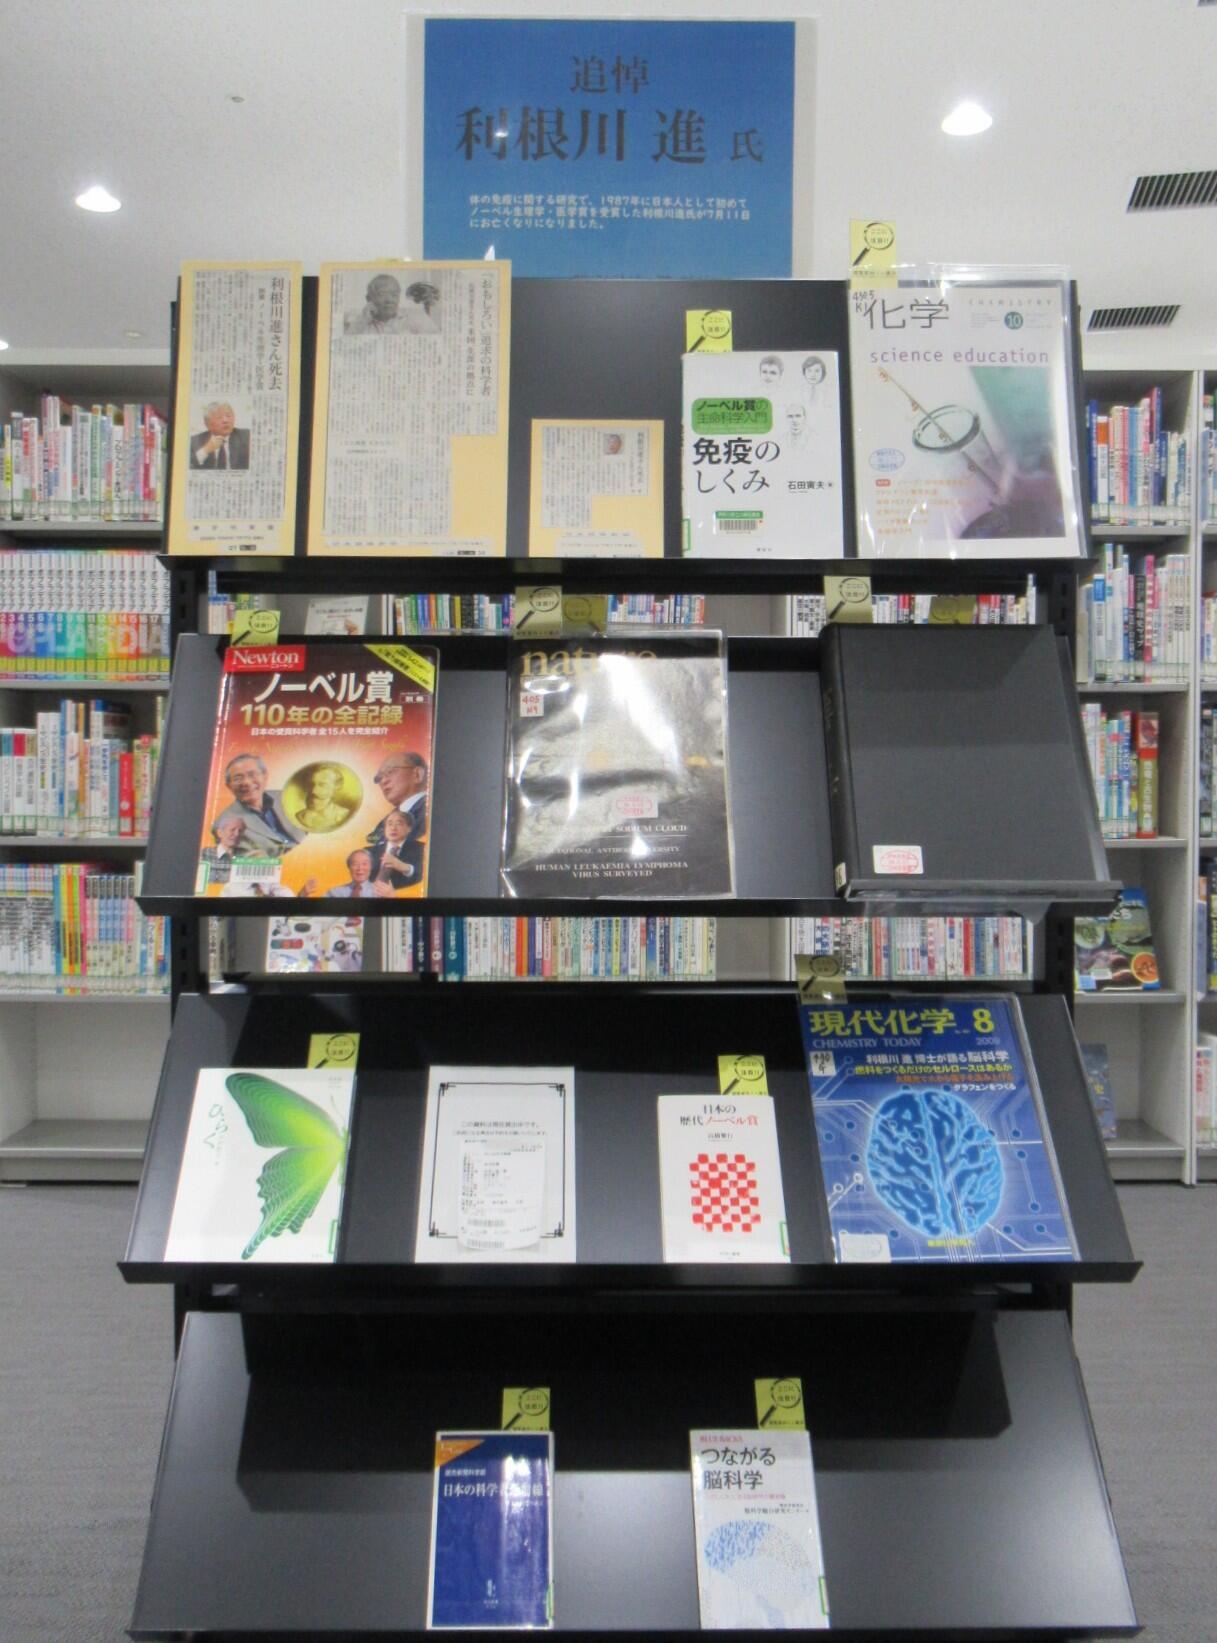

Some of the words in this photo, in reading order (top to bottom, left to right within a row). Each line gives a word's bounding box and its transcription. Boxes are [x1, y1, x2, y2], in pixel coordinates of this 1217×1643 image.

[570, 55, 649, 94] 追悼
[456, 105, 626, 162] 利根川
[652, 108, 706, 164] 進
[730, 128, 764, 163] 氏
[864, 298, 949, 330] 化学
[1007, 314, 1022, 327] 10
[268, 277, 285, 391] 利根川進さん死去
[870, 348, 943, 363] science
[953, 348, 1049, 363] education
[696, 400, 768, 412] ノーベル賞の
[692, 437, 781, 465] 免疫の
[696, 469, 770, 494] しくみ
[232, 649, 299, 665] Newton
[254, 670, 394, 704] ノーベル賞
[240, 703, 404, 726] 110年の全記録
[603, 870, 653, 878] SURVEYED
[634, 861, 688, 869] LYMPHOMA
[808, 1008, 957, 1037] 現代化学
[972, 1008, 995, 1034] 8
[812, 1038, 877, 1049] CHEMISTRY
[883, 1037, 922, 1048] TODAY
[703, 1104, 737, 1114] 日本の
[680, 1115, 759, 1126] 歴代ノーベル賞
[701, 1447, 776, 1466] つながる
[703, 1470, 764, 1490] 脳科学
